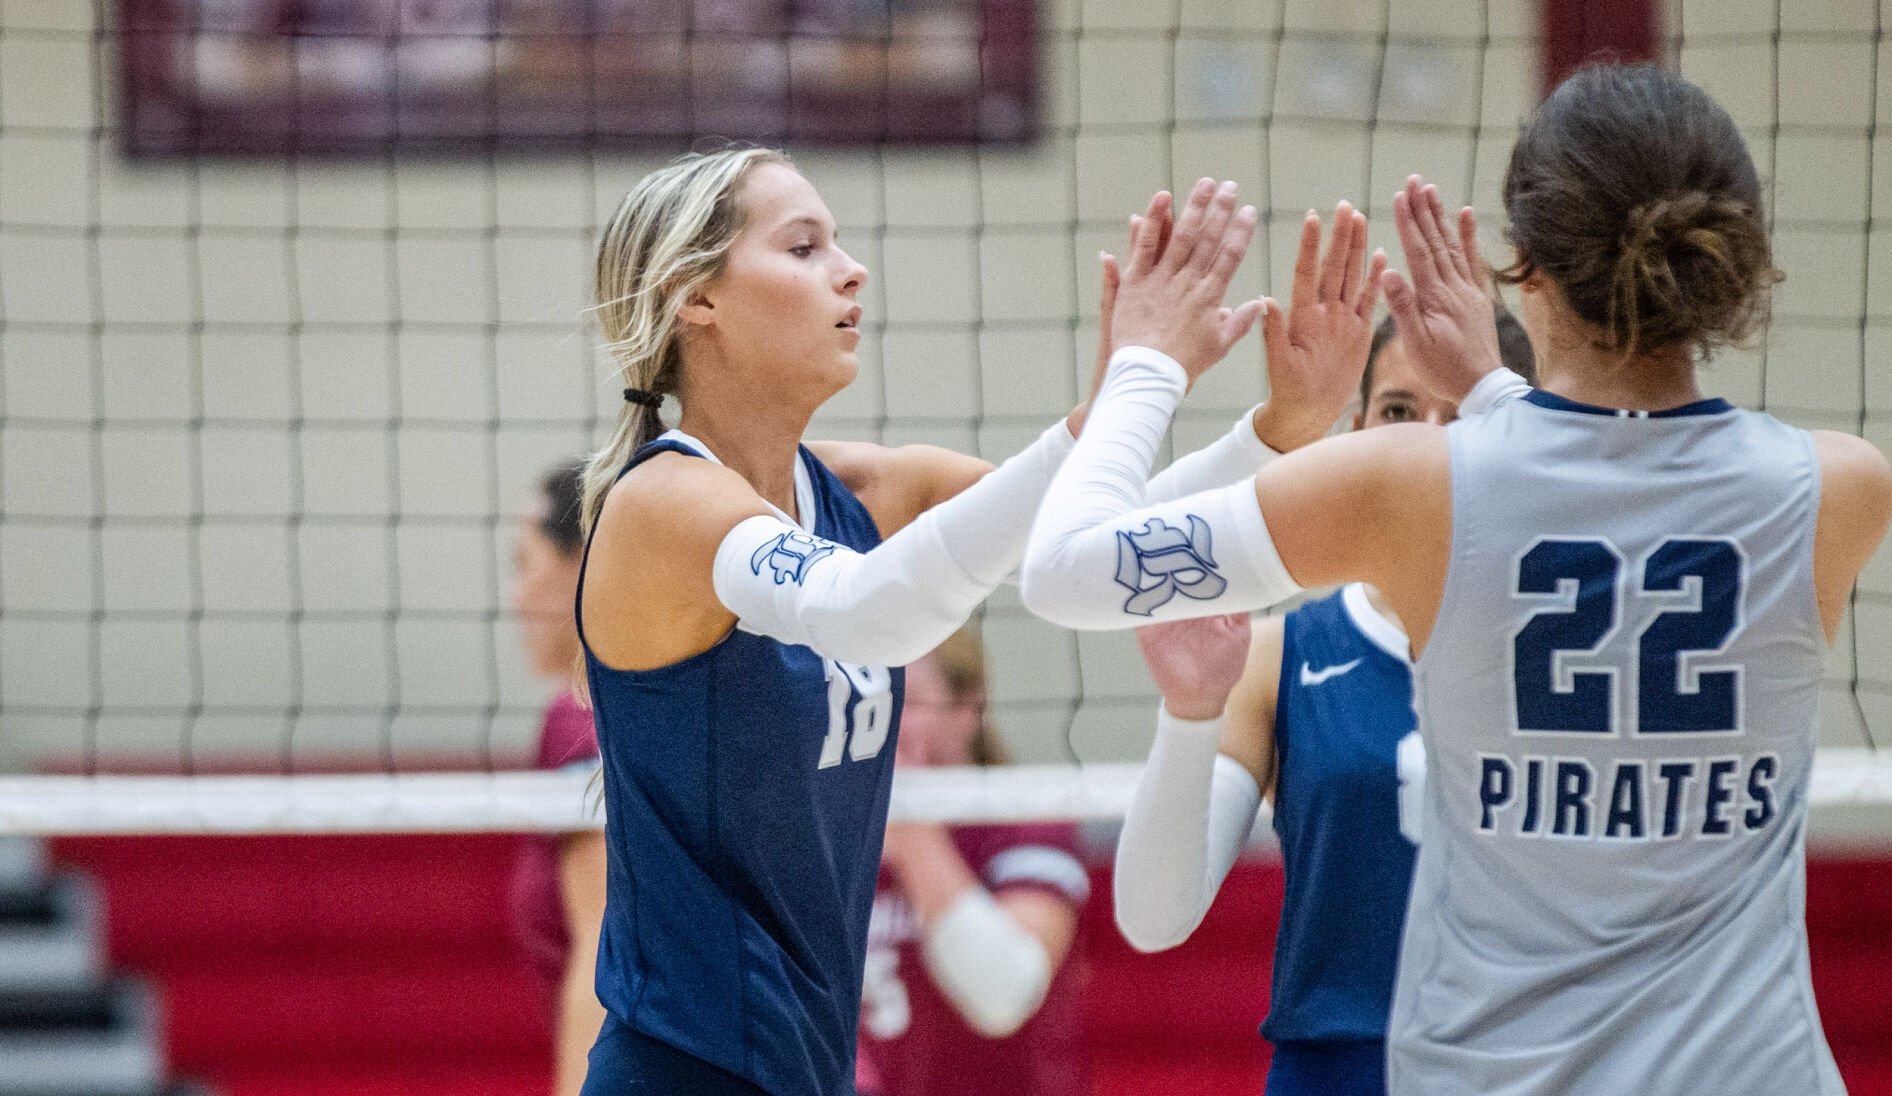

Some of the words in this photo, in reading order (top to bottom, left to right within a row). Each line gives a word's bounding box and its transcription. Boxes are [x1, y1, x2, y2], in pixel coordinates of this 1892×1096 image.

[1511, 534, 1747, 739] 22
[817, 657, 894, 770] 18
[1475, 752, 1780, 842] PIRATES
